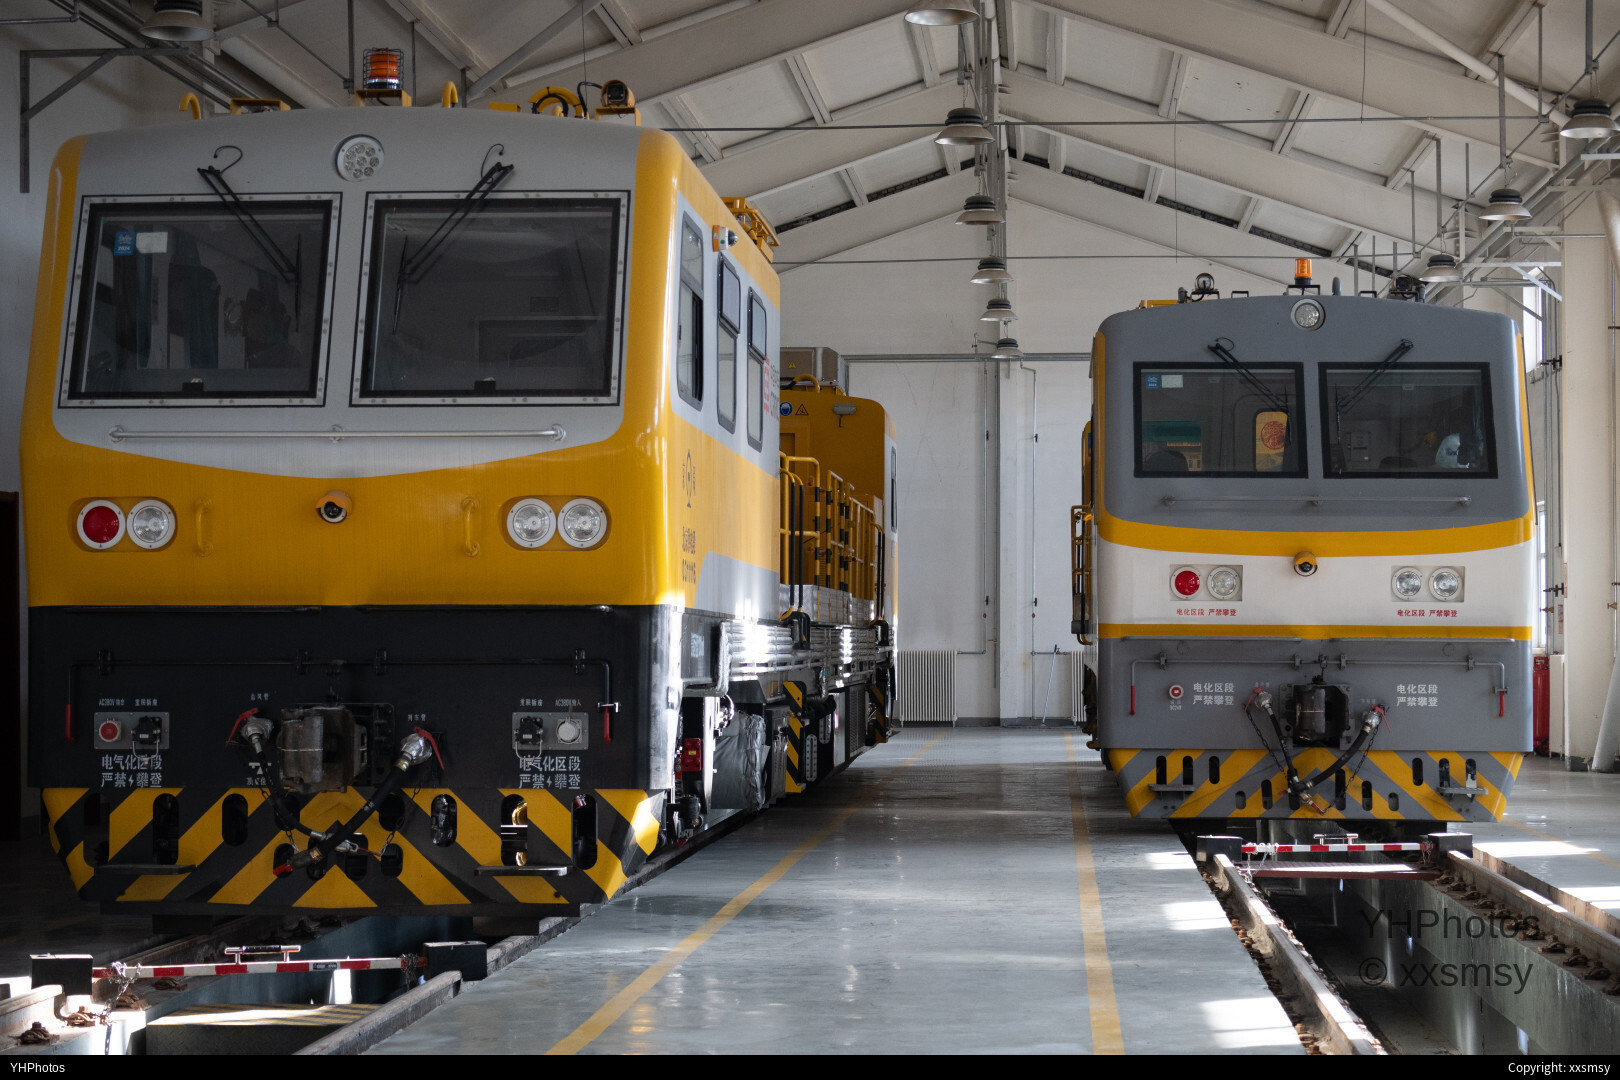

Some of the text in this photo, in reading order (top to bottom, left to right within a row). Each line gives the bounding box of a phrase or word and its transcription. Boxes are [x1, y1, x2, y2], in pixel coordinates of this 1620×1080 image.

[1177, 608, 1236, 617] 电化区段 严禁攀登
[1397, 609, 1458, 618] 电化区段 严禁攀登
[1193, 682, 1234, 693] 电化区段
[1396, 684, 1438, 694] 电化区段
[1193, 695, 1234, 706] 严禁攀登
[1396, 696, 1438, 707] 严禁攀登
[101, 753, 163, 770] 电气化区段
[519, 755, 581, 772] 电气化区段
